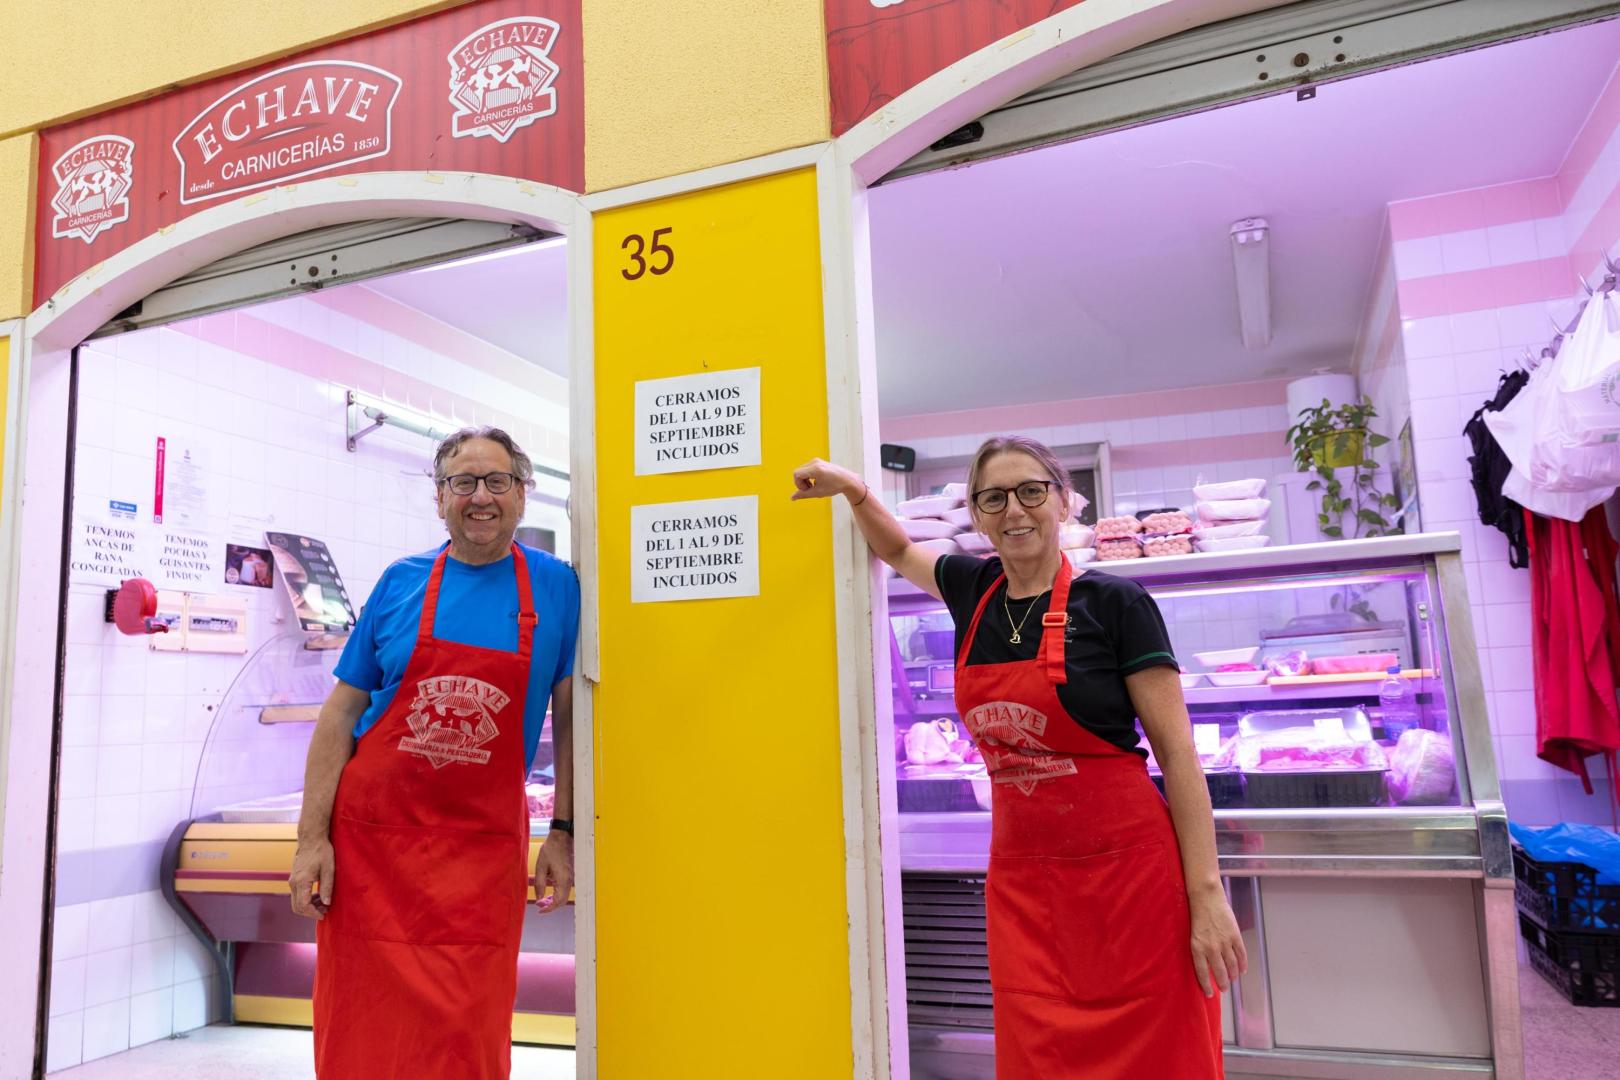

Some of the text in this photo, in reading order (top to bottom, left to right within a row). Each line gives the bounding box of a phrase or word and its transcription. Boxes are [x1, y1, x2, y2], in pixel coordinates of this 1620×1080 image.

[460, 25, 547, 65] ECHAVE
[193, 76, 379, 165] ECHAVE
[473, 102, 534, 125] CARNICERÍAS
[62, 142, 126, 175] ECHAVE
[189, 136, 380, 193] desde 1850
[221, 132, 345, 181] CARNICERÍAS
[621, 226, 675, 281] 35
[655, 386, 740, 408] CERRAMOS
[649, 404, 747, 426] DEL 1 AL 9 DE
[649, 422, 746, 444] SEPTIEMBRE
[656, 441, 739, 461] INCLUIDOS
[85, 525, 136, 540] TENEMOS
[651, 514, 738, 534] CERRAMOS
[84, 537, 135, 552] ANCAS DE
[165, 534, 208, 548] TENEMOS
[646, 532, 745, 552] DEL 1 AL 9 DE
[94, 551, 123, 563] RANA
[164, 547, 200, 560] POCHAS
[646, 551, 744, 571] SEPTIEMBRE
[71, 561, 143, 578] CONGELADAS
[159, 558, 211, 572] GUISANTES
[653, 570, 737, 589] INCLUIDOS
[423, 680, 506, 710] ECHAVE
[971, 705, 1044, 731] CHAVE
